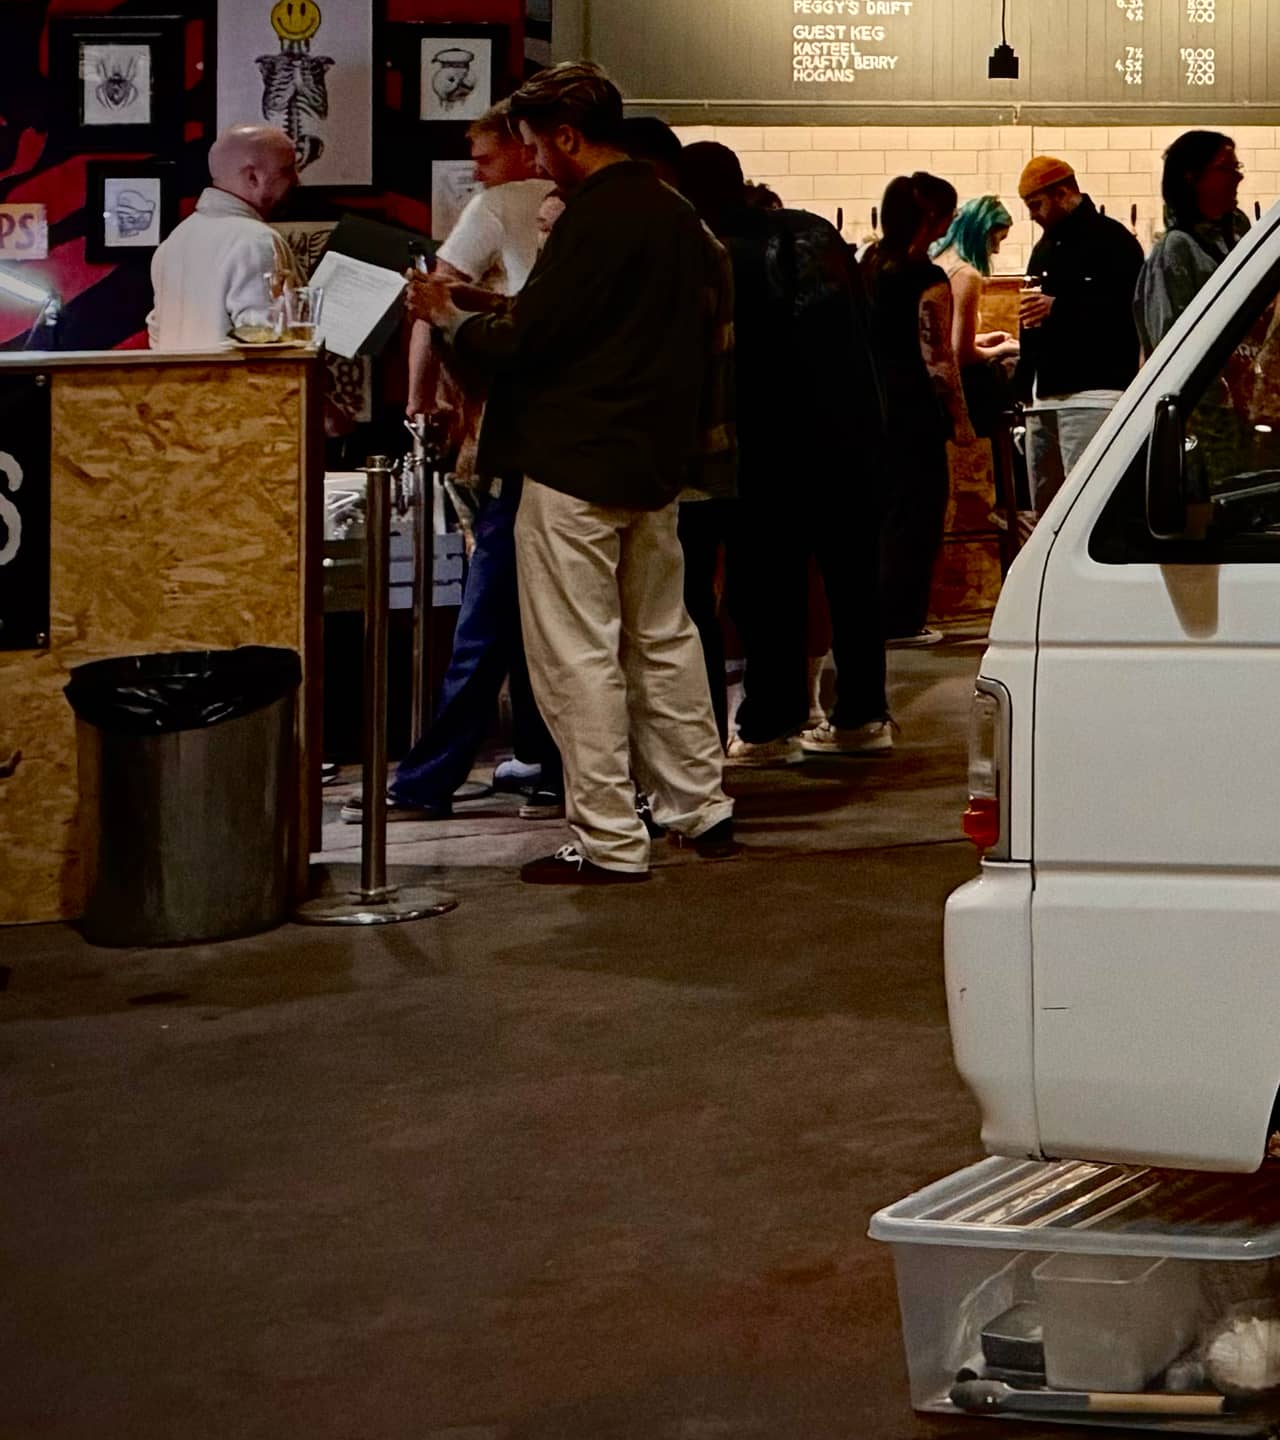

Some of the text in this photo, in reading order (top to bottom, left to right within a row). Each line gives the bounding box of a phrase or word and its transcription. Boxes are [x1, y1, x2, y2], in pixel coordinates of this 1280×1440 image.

[793, 0, 859, 15] PEGGY'S
[866, 1, 912, 16] DRIFT
[1187, 10, 1215, 23] 7.00
[793, 25, 885, 41] GUEST KEG
[793, 42, 861, 56] KASTEEL
[1125, 47, 1144, 59] 7%
[793, 55, 849, 69] CRAFTY
[854, 56, 898, 70] BERRY
[793, 68, 855, 83] HOGANS
[1185, 72, 1215, 85] 7.00
